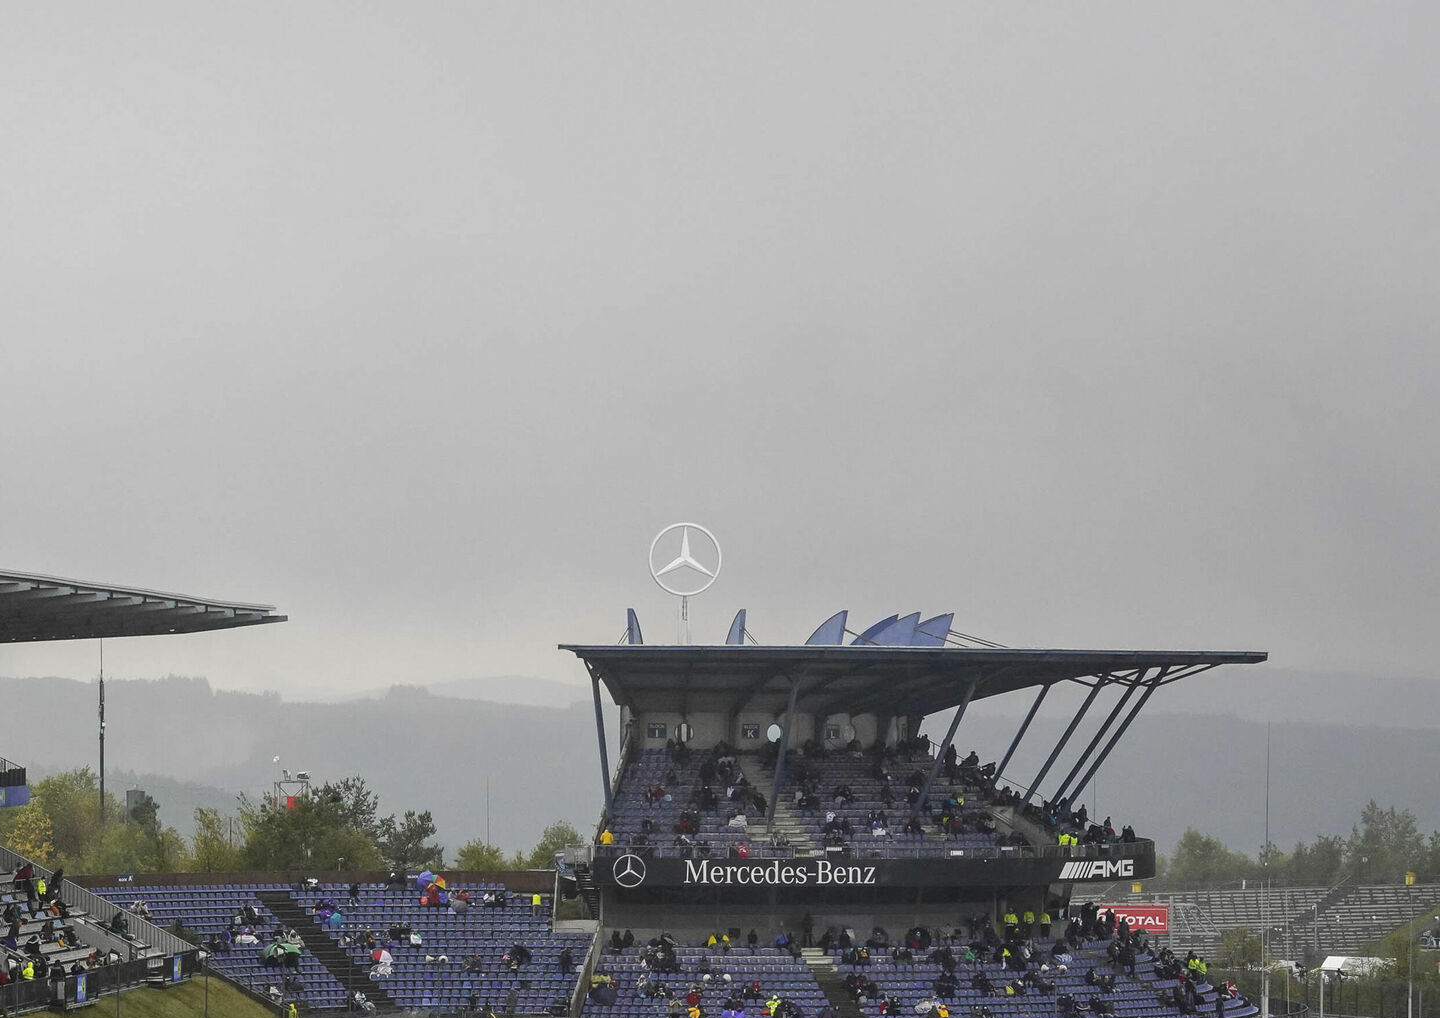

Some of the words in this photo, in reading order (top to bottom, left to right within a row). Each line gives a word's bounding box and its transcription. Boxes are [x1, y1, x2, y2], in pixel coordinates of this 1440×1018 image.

[684, 859, 876, 885] Mercedes-Benz
[1088, 859, 1134, 878] AMG
[1116, 913, 1165, 926] TOTAL
